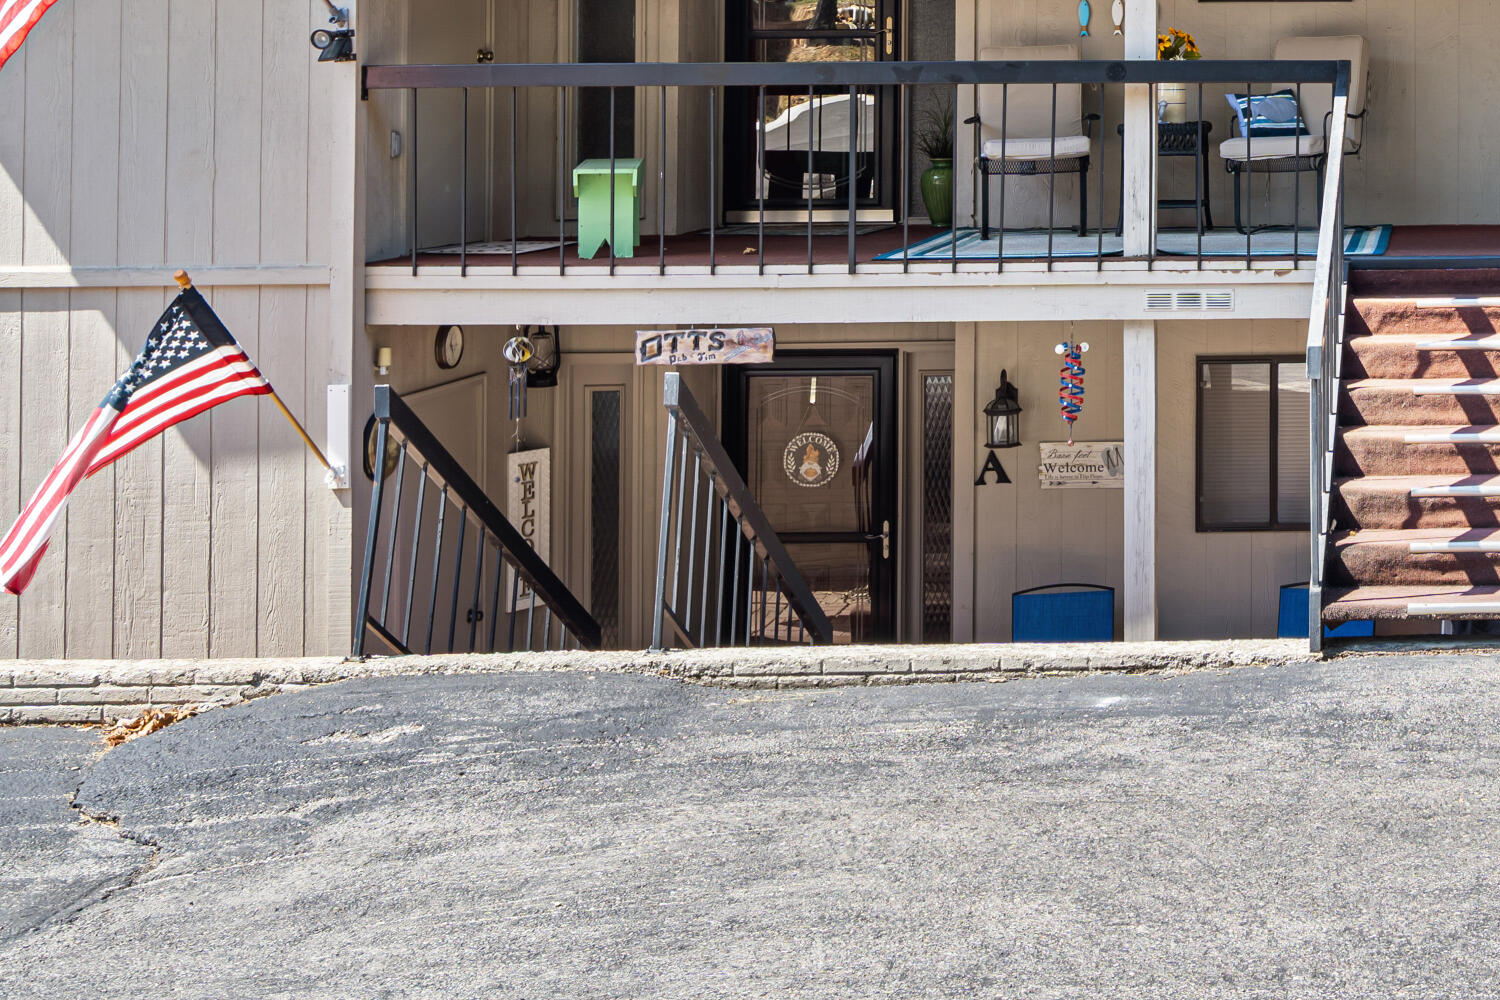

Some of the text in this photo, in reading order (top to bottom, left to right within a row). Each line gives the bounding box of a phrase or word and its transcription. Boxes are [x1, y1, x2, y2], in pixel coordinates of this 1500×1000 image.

[640, 331, 726, 363] OTTS
[789, 436, 834, 454] WELCOME
[974, 449, 1012, 486] A
[1043, 462, 1105, 473] Welcome
[518, 461, 538, 598] WELCE
